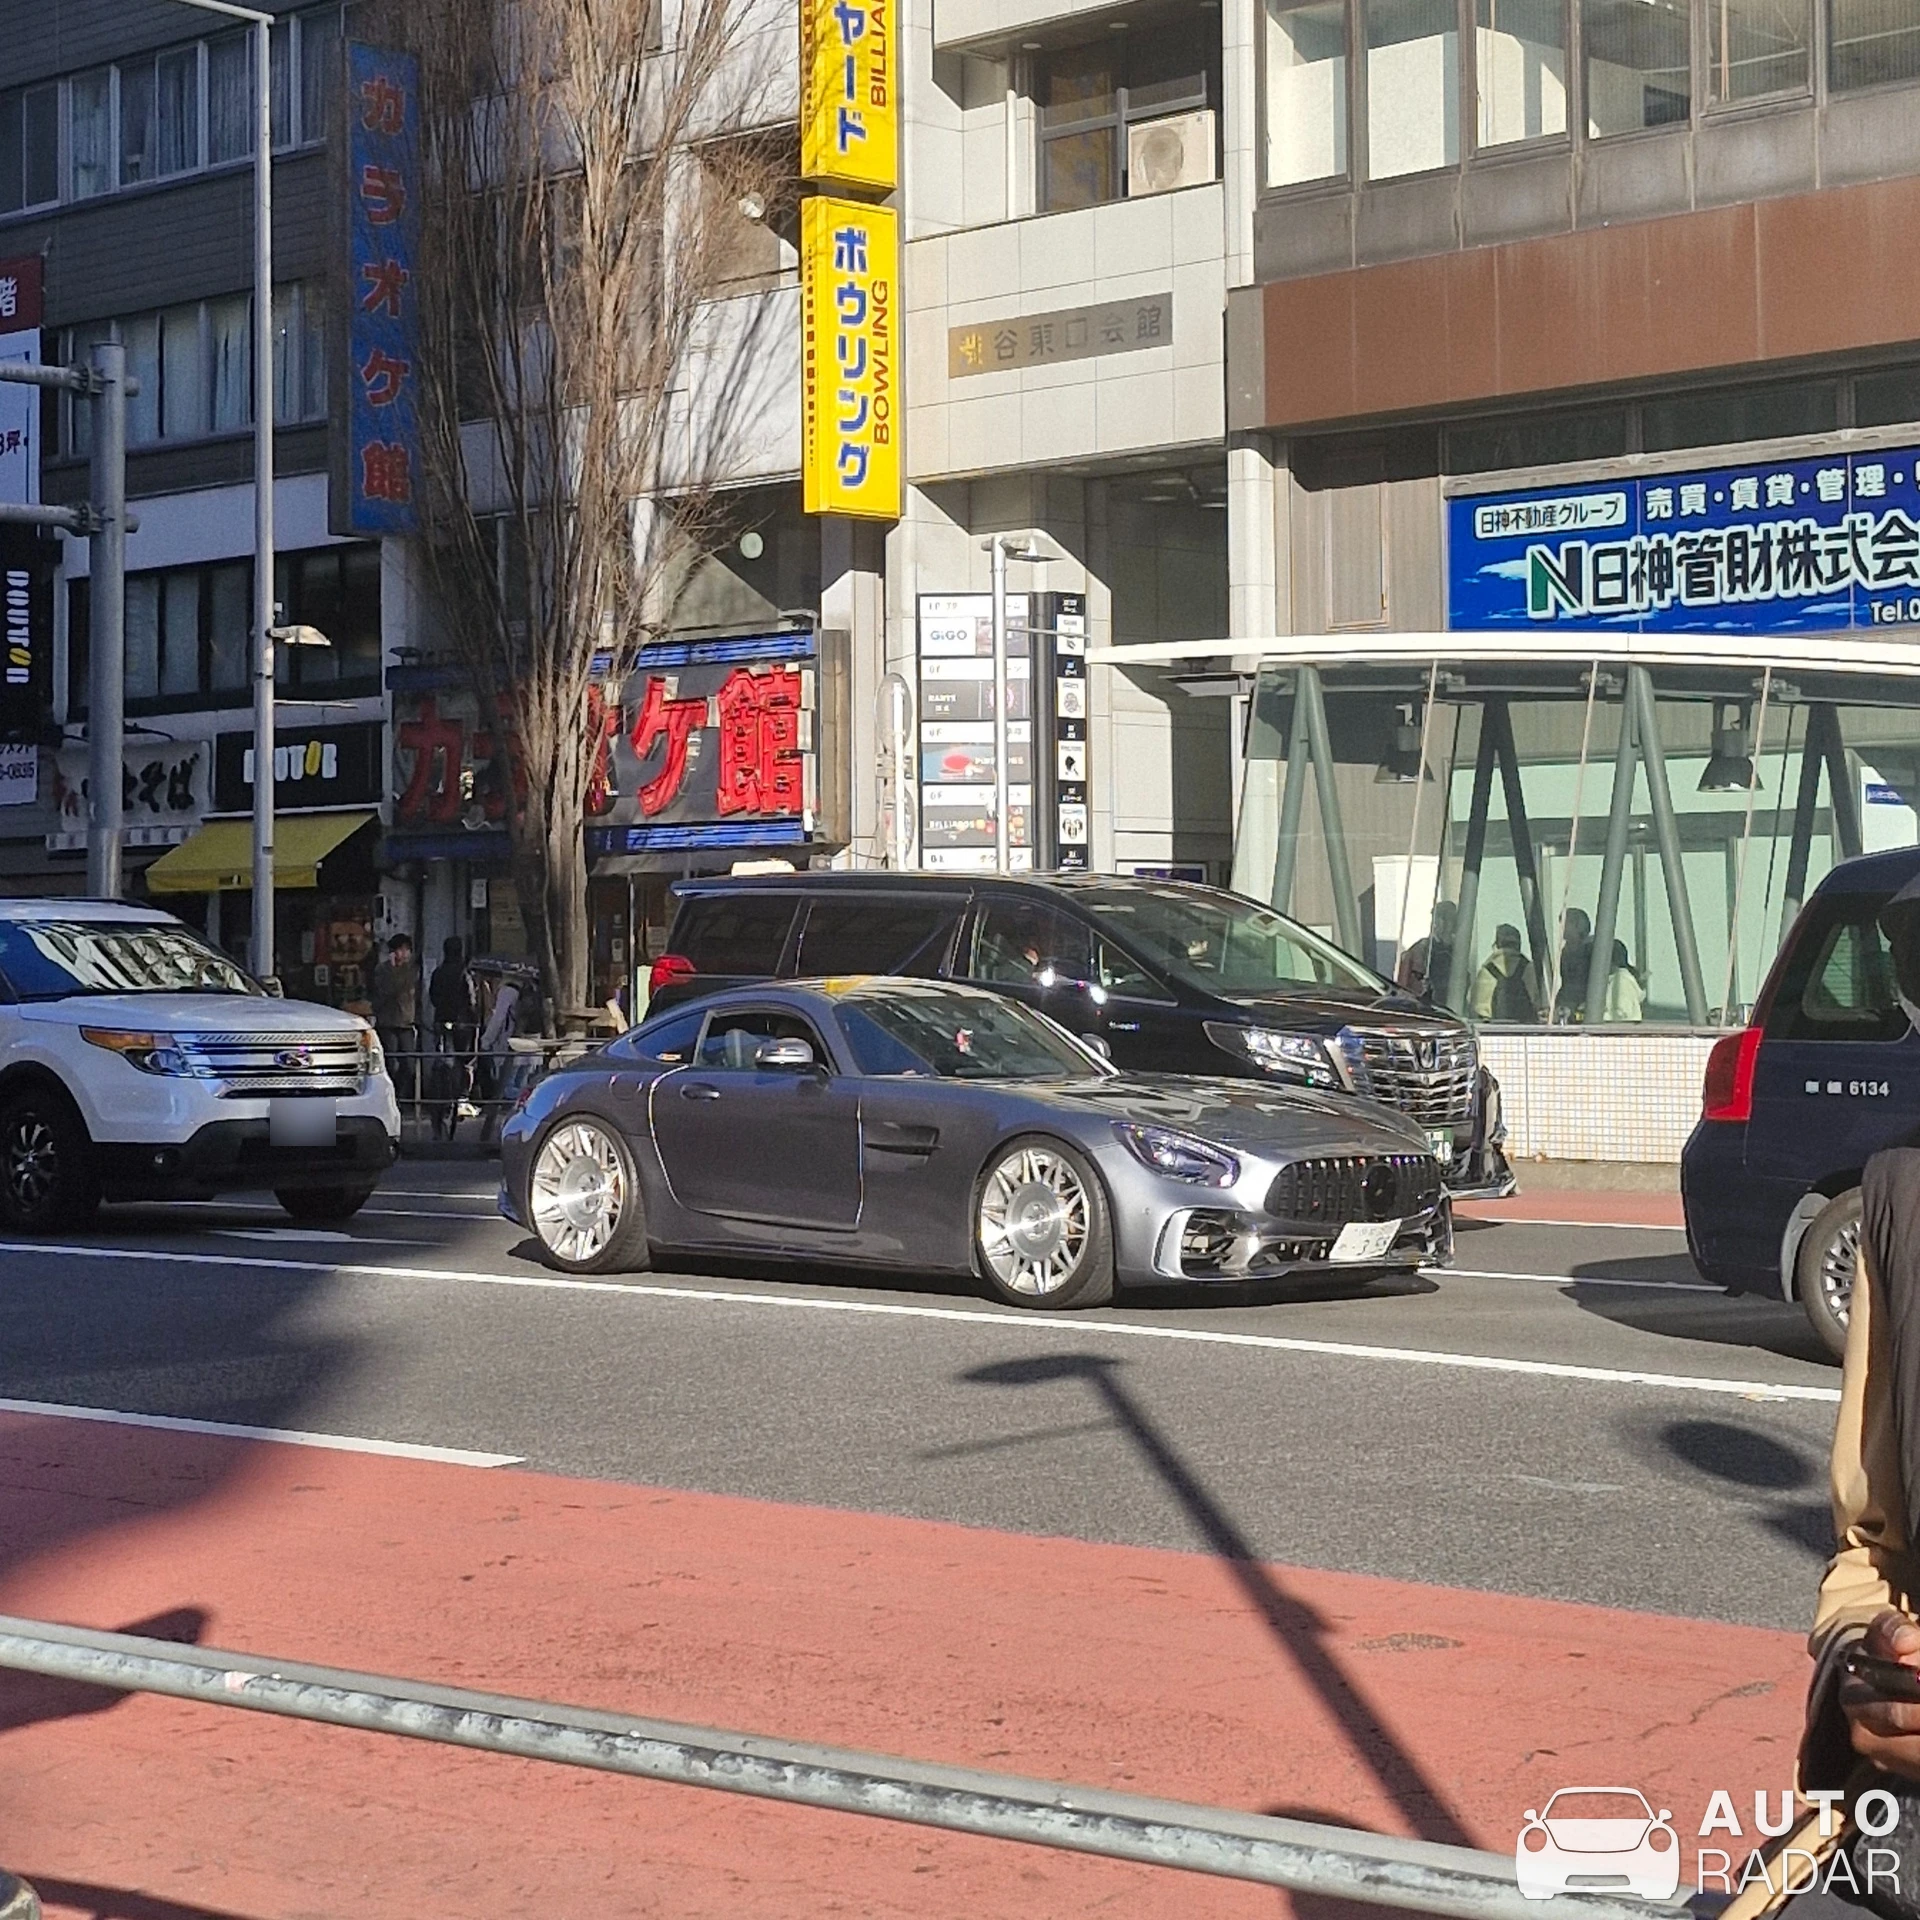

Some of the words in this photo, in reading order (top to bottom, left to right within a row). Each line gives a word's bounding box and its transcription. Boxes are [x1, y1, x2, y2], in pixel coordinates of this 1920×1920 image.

[361, 74, 410, 503] カラオケ館
[835, 227, 870, 487] ボウリング
[872, 280, 889, 444] BOWLING
[1480, 497, 1620, 533] 日神不動産グループ
[1645, 459, 1920, 520] 売買・賃貸・管理・
[6, 570, 32, 684] DOUTOR
[243, 740, 338, 783] DUTOR
[1849, 1080, 1890, 1097] 6134
